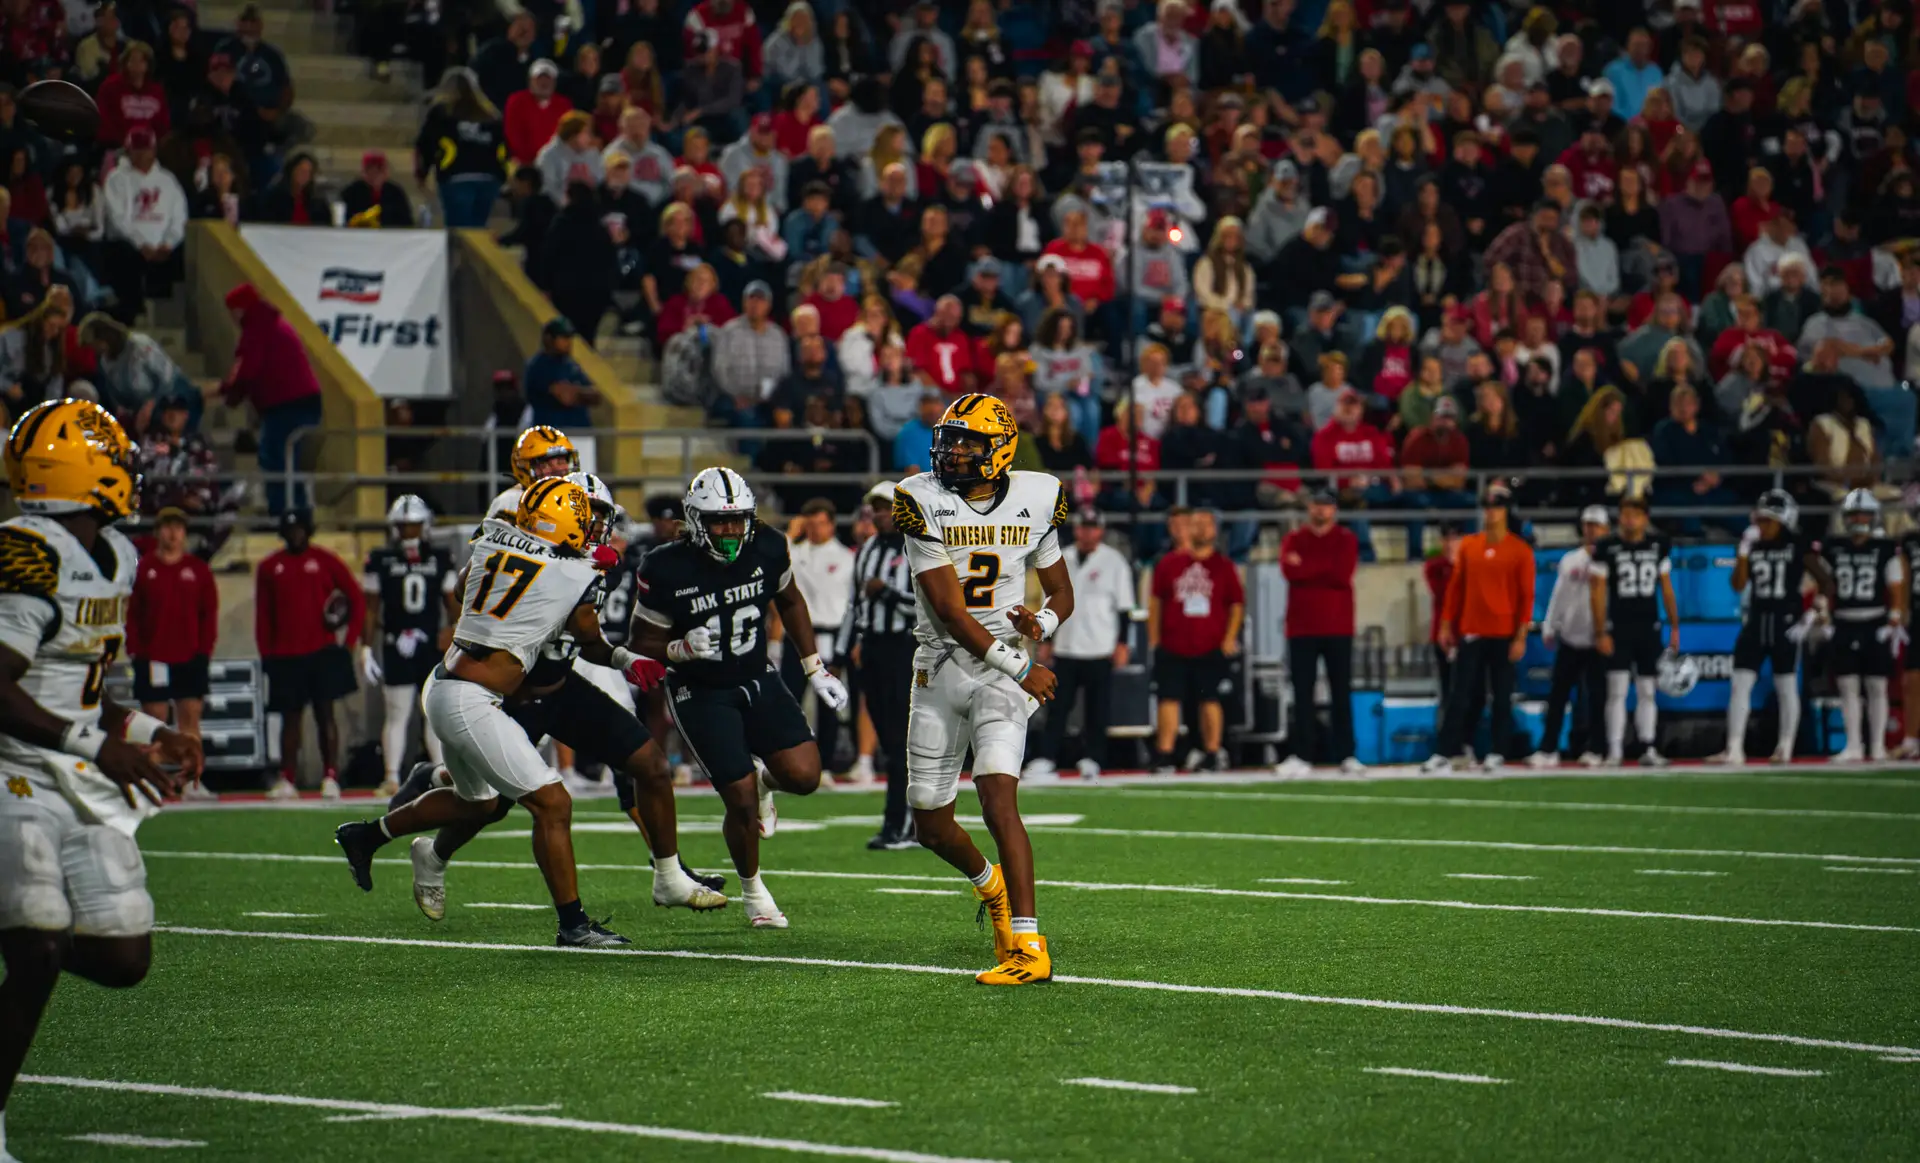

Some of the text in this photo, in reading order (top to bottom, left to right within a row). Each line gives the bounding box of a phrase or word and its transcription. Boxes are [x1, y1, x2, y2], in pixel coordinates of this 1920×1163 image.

[1001, 526, 1031, 546] STATE
[470, 549, 547, 621] 17
[690, 579, 764, 615] JAX STATE
[963, 551, 1002, 609] 2
